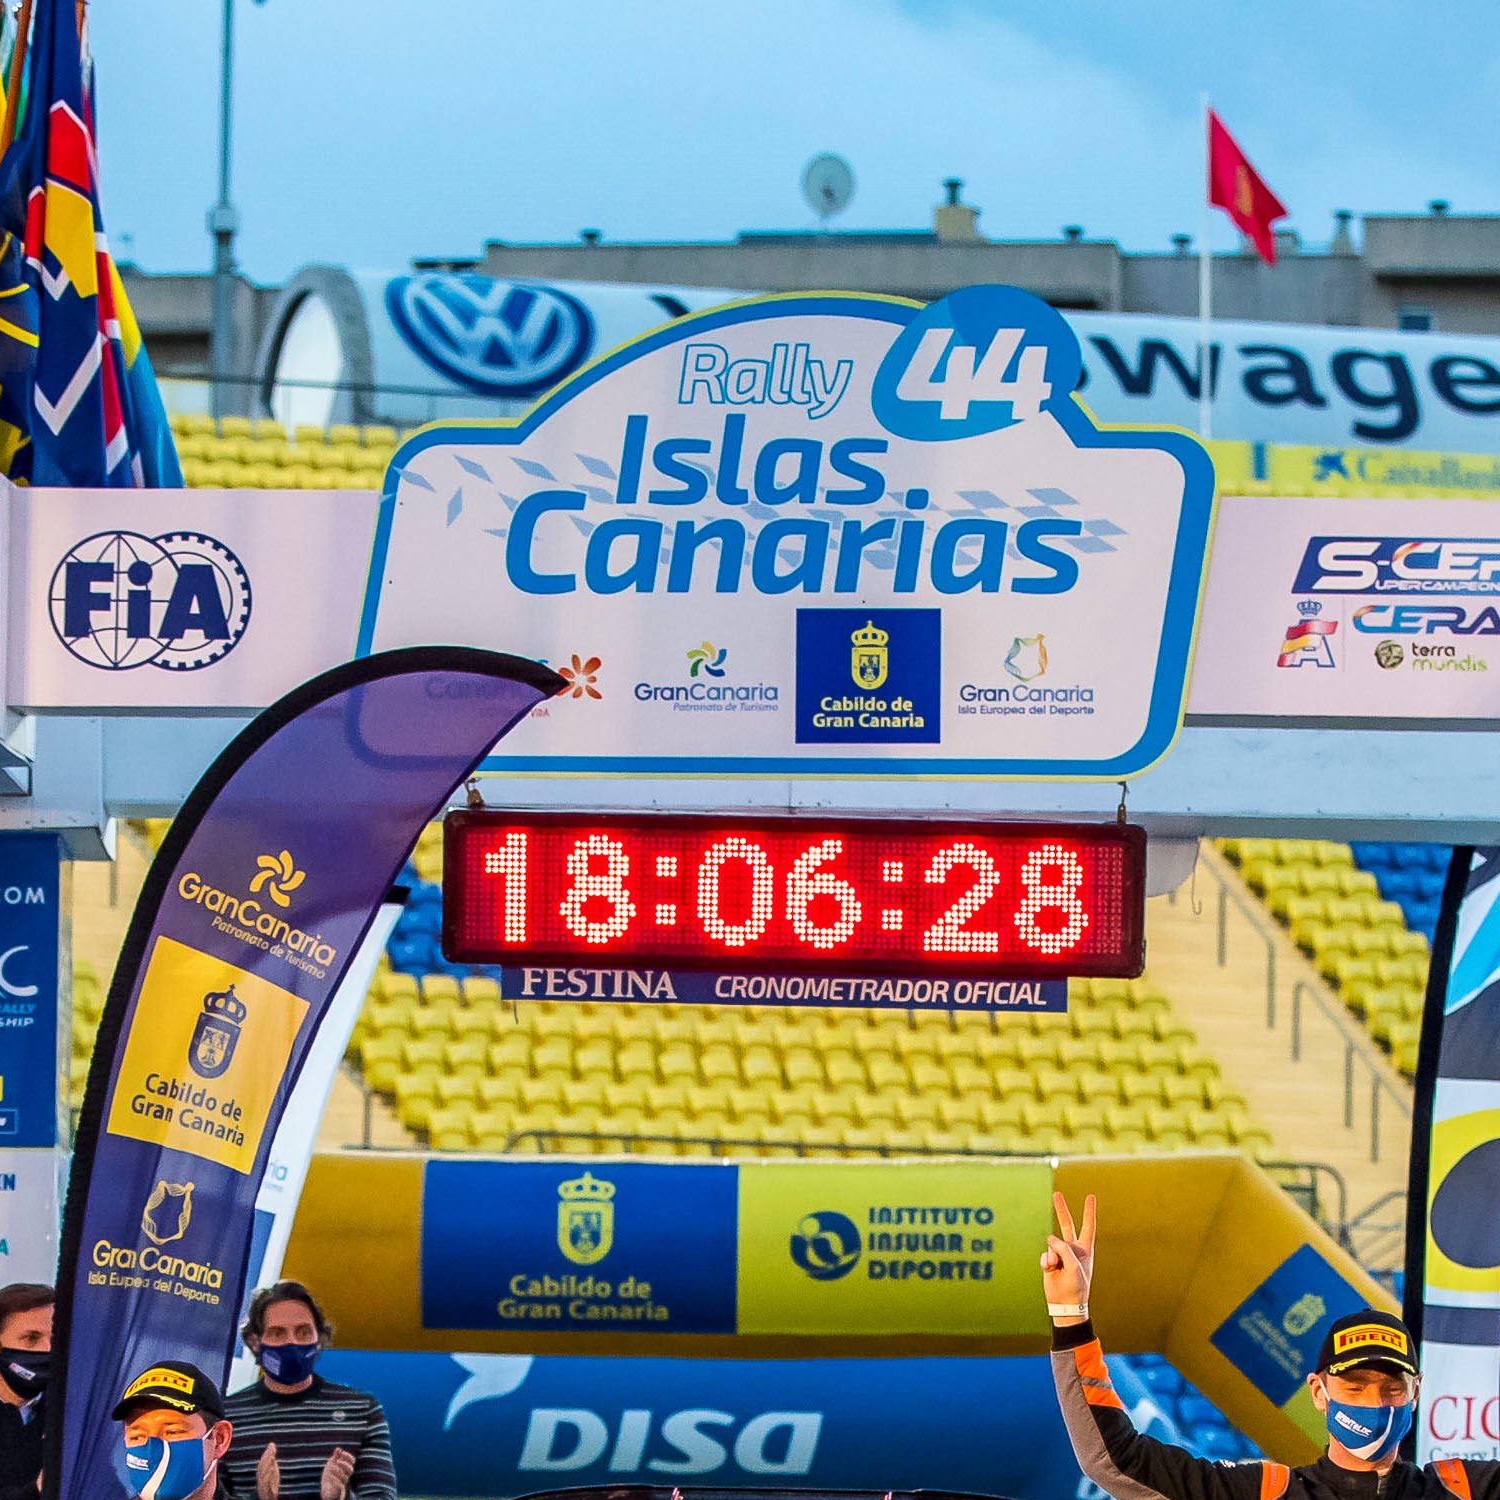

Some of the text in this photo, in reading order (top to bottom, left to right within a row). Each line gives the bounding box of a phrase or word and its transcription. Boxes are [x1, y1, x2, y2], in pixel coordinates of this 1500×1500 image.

[678, 342, 853, 420] Rally
[897, 326, 1053, 421] 44
[616, 414, 890, 508] Islas
[504, 488, 1083, 597] Canarias
[1412, 642, 1456, 657] terra
[1412, 654, 1488, 672] mundis
[634, 681, 780, 703] GranCanaria
[820, 695, 914, 714] Cabildo de
[959, 684, 1094, 704] Gran Canaria
[812, 711, 925, 731] Gran Canaria
[958, 704, 1095, 718] Isla Europea del Deporte
[483, 832, 1091, 958] 18:06:28
[177, 871, 338, 968] GranCanaria
[211, 915, 326, 980] Patronato de Turismo
[520, 967, 1049, 1006] FESTINA CRONOMETRADOR OFICIAL
[145, 1072, 243, 1121] Cabildo de
[131, 1094, 245, 1147] Gran Canaria
[868, 1258, 994, 1282] DEPORTES
[509, 1275, 652, 1301] Cabildo de
[497, 1297, 670, 1322] Gran Canaria
[1338, 1328, 1406, 1350] PIRELLI
[518, 1408, 825, 1476] DISA
